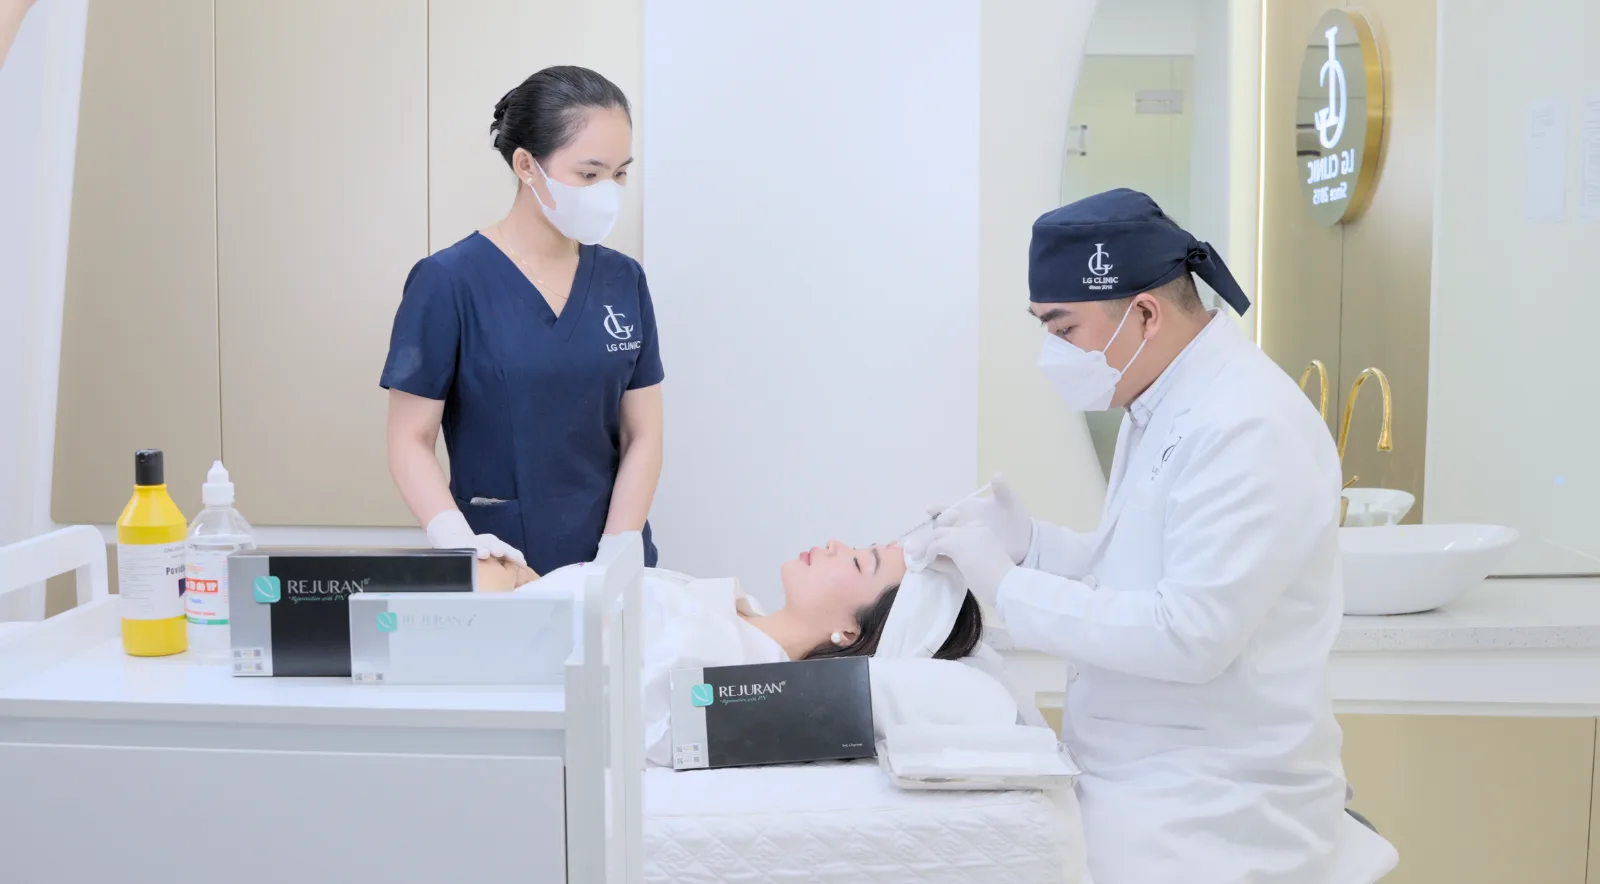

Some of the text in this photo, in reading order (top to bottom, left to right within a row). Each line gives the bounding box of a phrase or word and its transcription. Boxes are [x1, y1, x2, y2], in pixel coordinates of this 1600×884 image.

[1093, 276, 1119, 284] CLINIC
[606, 340, 641, 352] LG CLINIC
